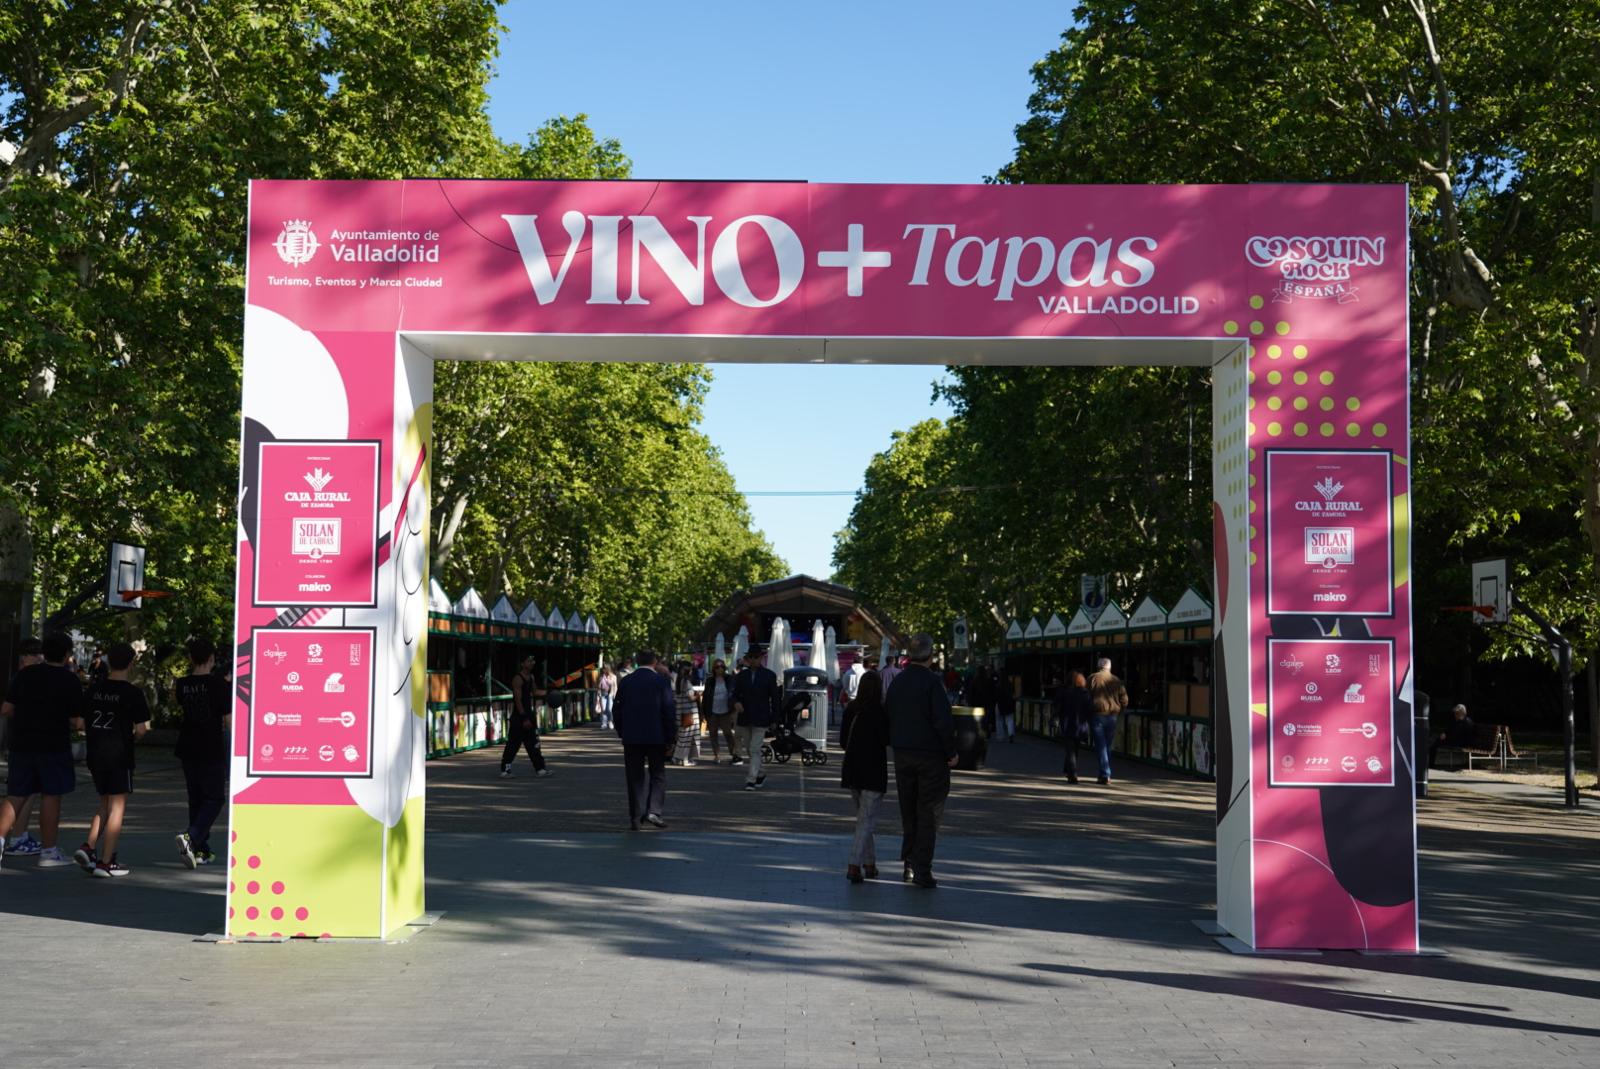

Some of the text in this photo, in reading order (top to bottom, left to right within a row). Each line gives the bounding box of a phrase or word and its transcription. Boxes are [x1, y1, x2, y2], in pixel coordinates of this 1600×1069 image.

[330, 229, 440, 242] Ayuntamiento de
[330, 244, 440, 263] Valladolid
[501, 210, 805, 308] VINO
[902, 223, 1158, 301] Tapas
[1245, 236, 1386, 267] COSQUIN
[1280, 259, 1350, 281] ROCK
[268, 276, 444, 289] Turismo, Eventos y Marca Ciudad
[1284, 282, 1345, 297] ESPAÑA
[1038, 296, 1200, 315] VALLADOLID
[284, 492, 351, 502] CAJA RURAL
[1295, 501, 1363, 511] CAJA RURAL
[298, 582, 332, 592] makro
[1313, 592, 1347, 602] makro
[92, 710, 115, 729] 22
